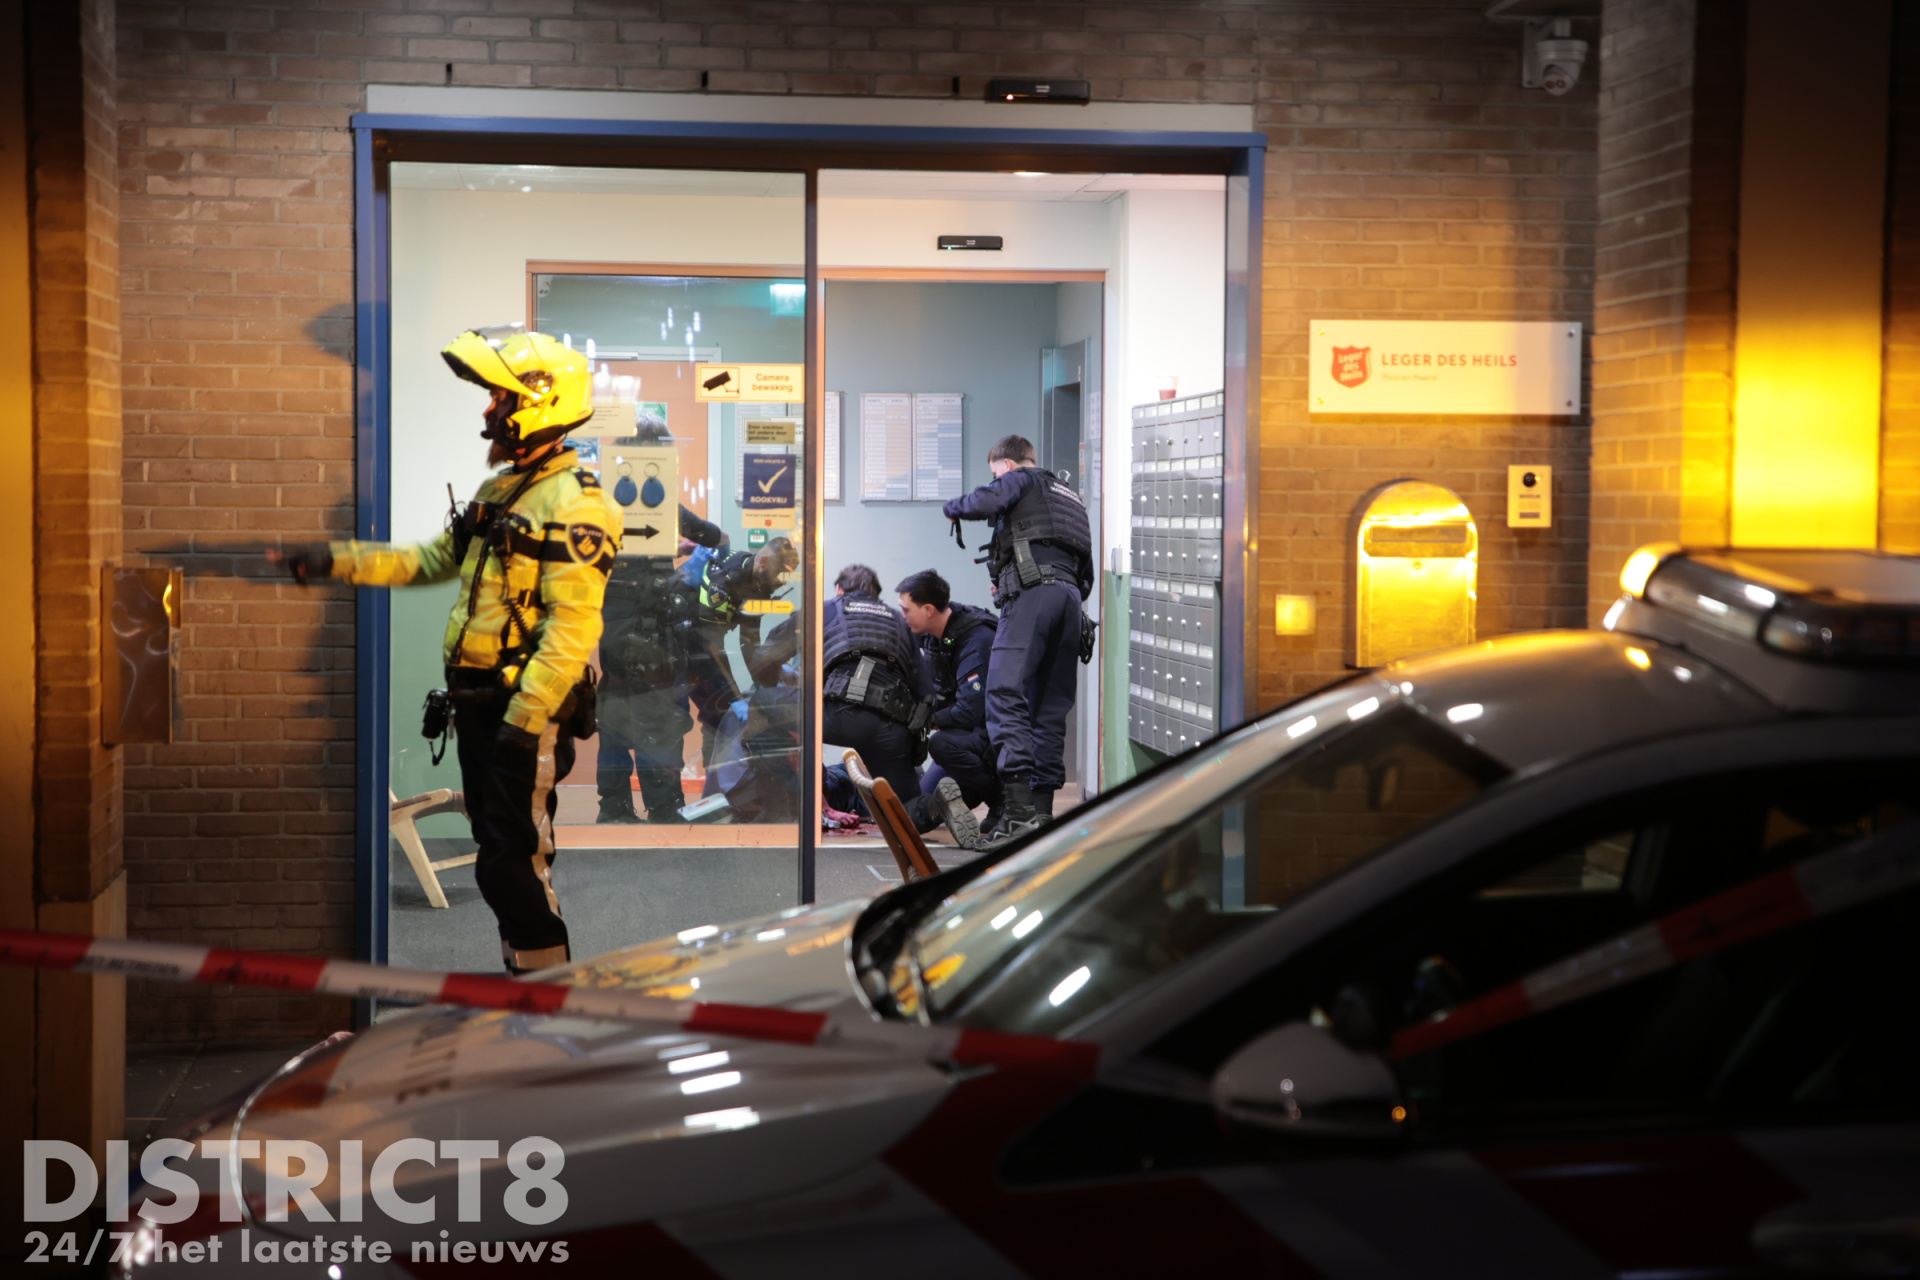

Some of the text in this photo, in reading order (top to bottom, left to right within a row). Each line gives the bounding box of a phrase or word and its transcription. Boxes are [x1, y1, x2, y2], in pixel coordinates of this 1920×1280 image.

[1381, 353, 1518, 368] LEGER DES HEILS
[756, 373, 789, 382] Camera
[752, 383, 793, 393] bewaking
[750, 496, 788, 504] ROOKVRIJ
